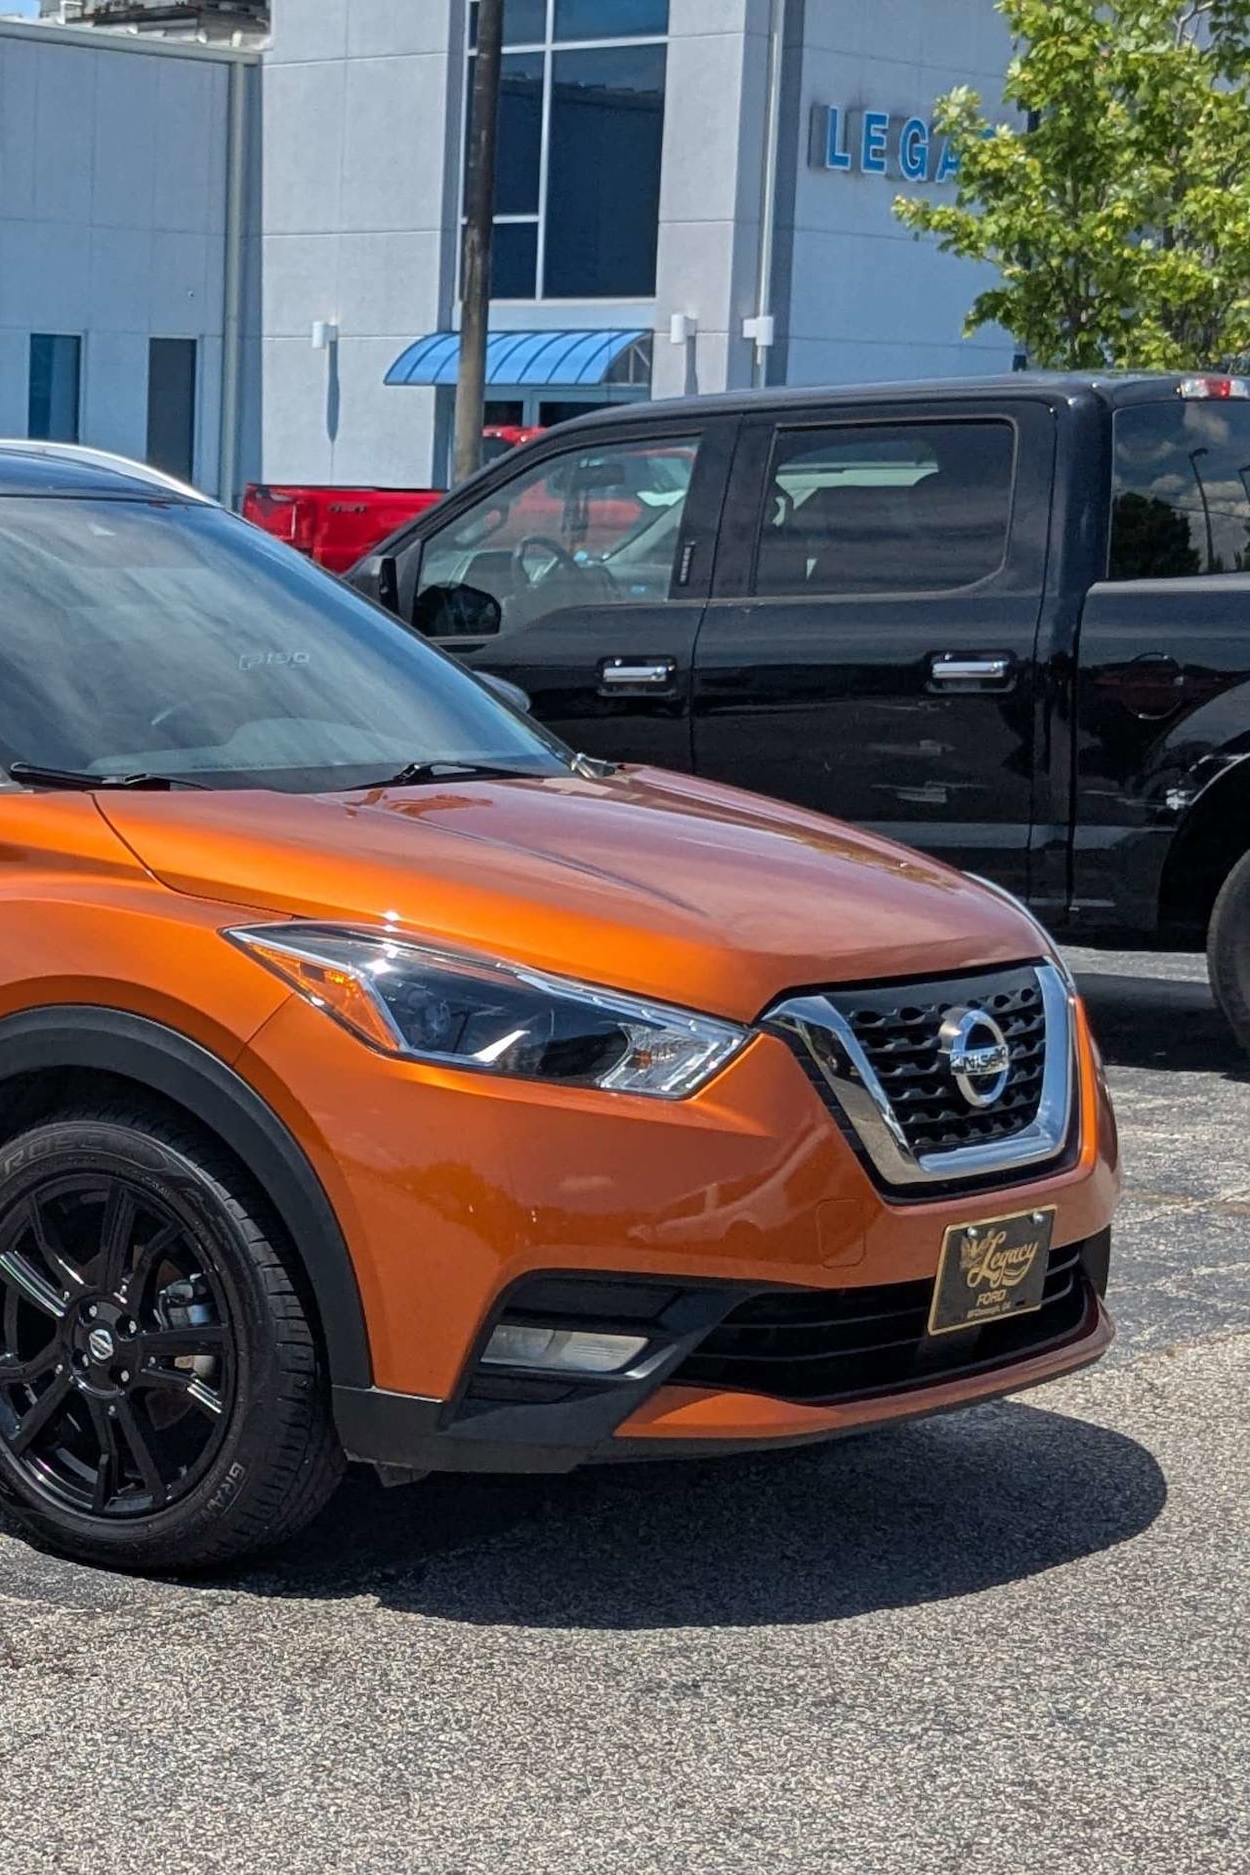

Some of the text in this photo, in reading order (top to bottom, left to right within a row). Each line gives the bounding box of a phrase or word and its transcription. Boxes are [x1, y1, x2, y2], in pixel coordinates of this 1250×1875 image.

[824, 105, 996, 183] LEG
[967, 1230, 1039, 1289] Legacy
[975, 1288, 1007, 1307] FORD
